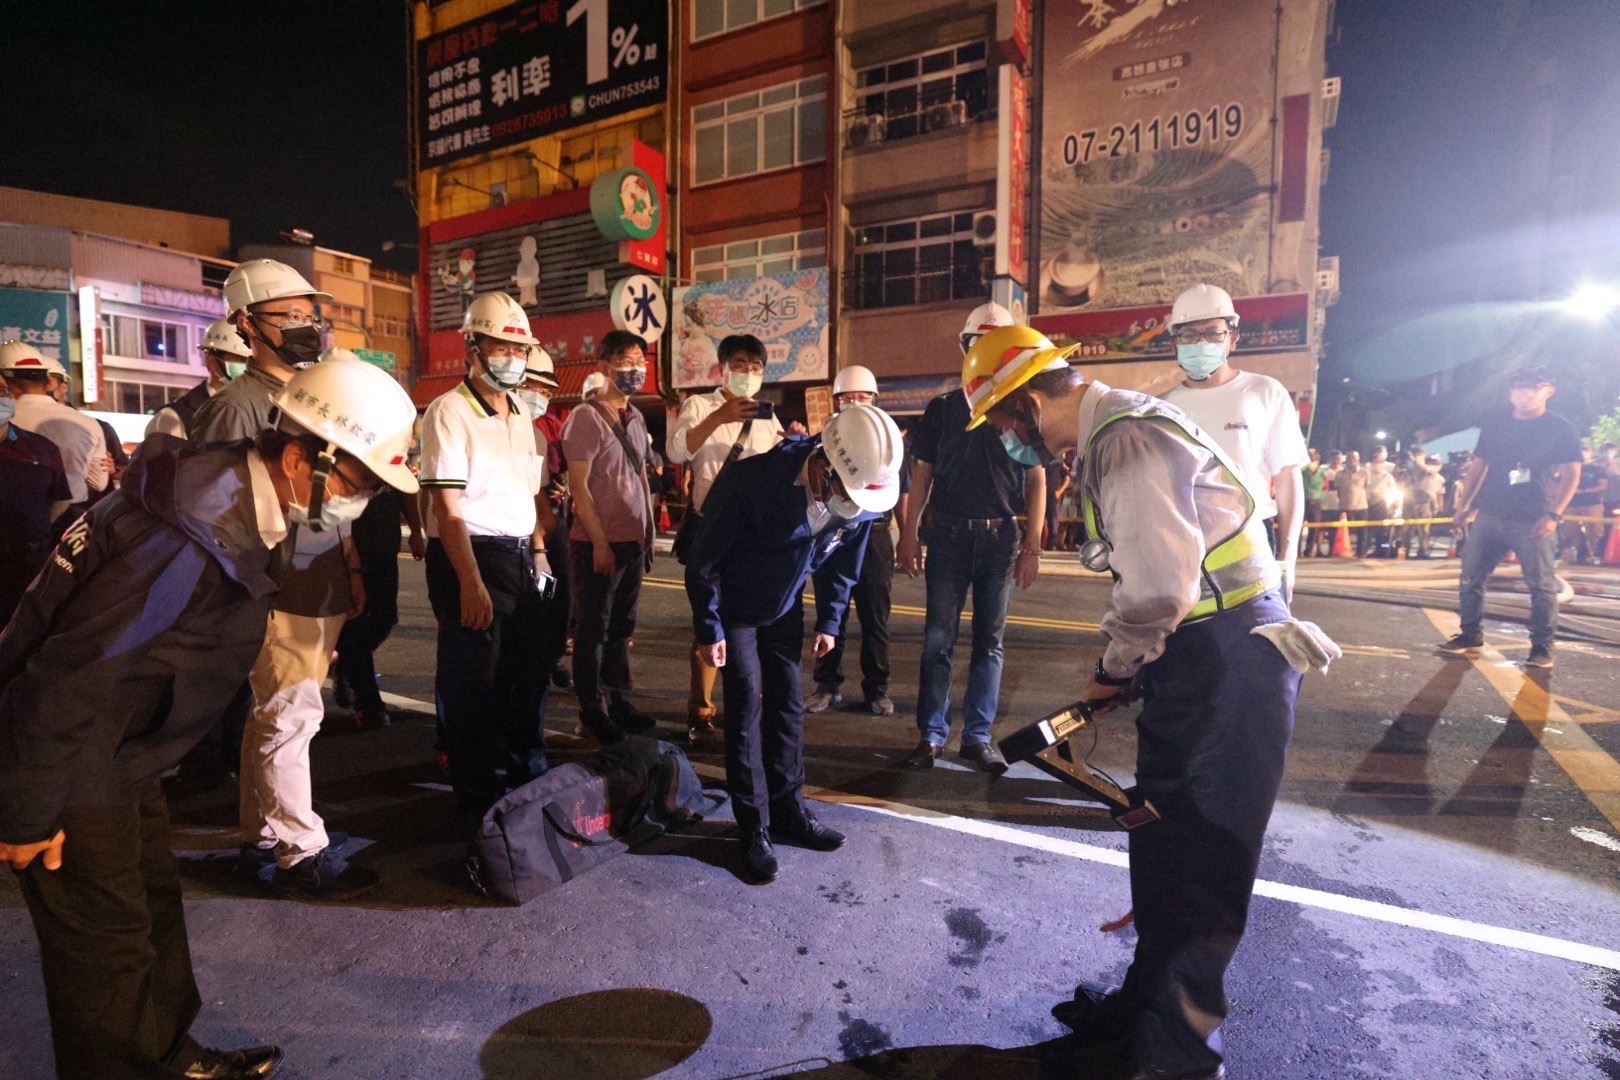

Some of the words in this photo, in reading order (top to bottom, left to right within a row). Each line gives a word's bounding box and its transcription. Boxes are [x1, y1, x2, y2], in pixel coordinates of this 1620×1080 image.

[491, 54, 550, 107] 利率
[1063, 104, 1243, 165] 07-2111919
[624, 283, 662, 335] 冰
